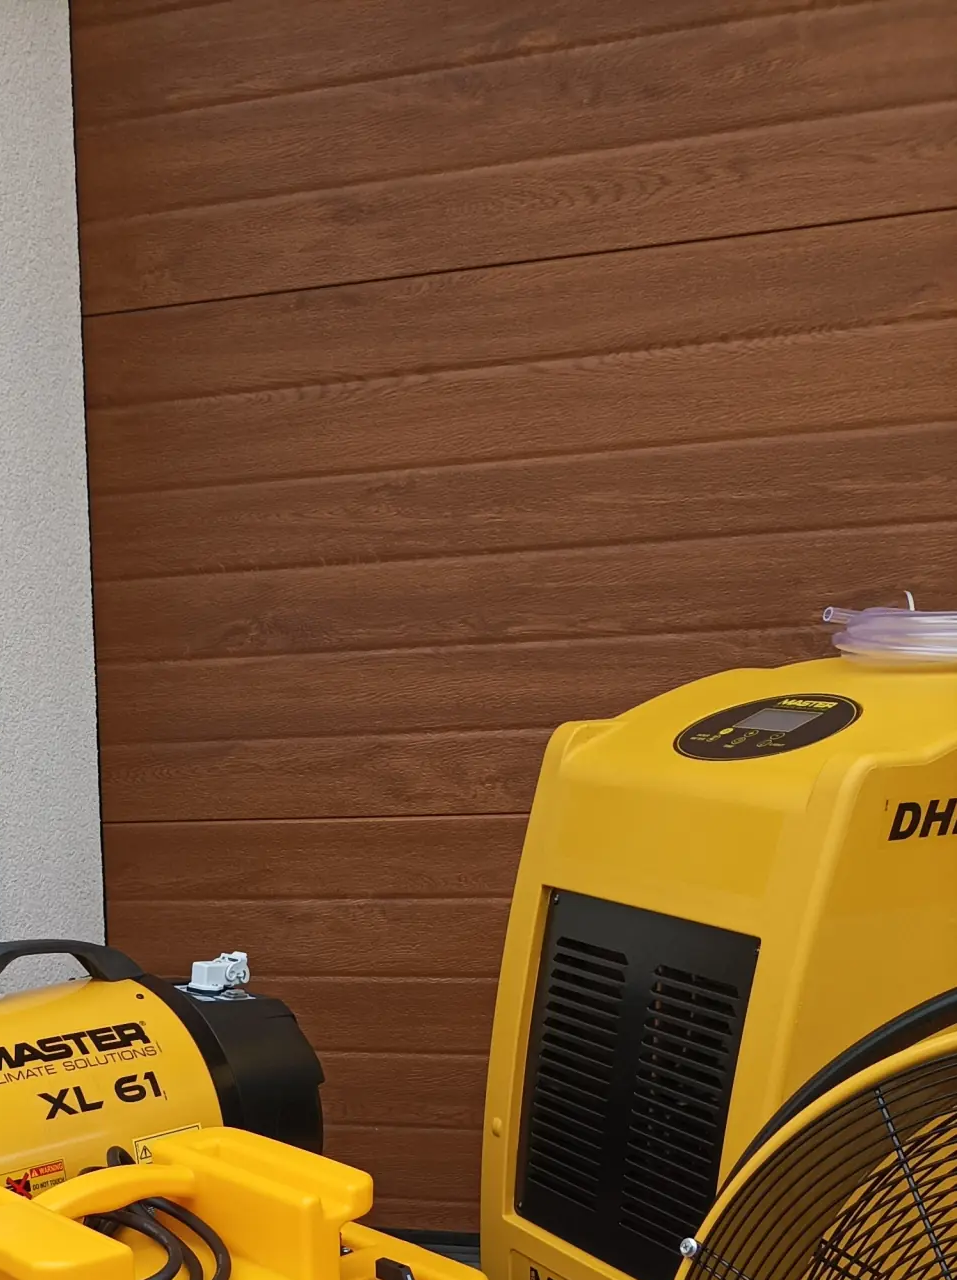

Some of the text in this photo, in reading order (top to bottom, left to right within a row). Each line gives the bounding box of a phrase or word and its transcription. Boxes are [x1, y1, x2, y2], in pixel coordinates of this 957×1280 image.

[777, 698, 839, 709] MASTER
[64, 1045, 157, 1073] SOLUTIONS
[37, 1071, 162, 1120] XL 61
[38, 1161, 63, 1176] WARNING
[32, 1183, 40, 1191] DO
[40, 1180, 49, 1189] NOT
